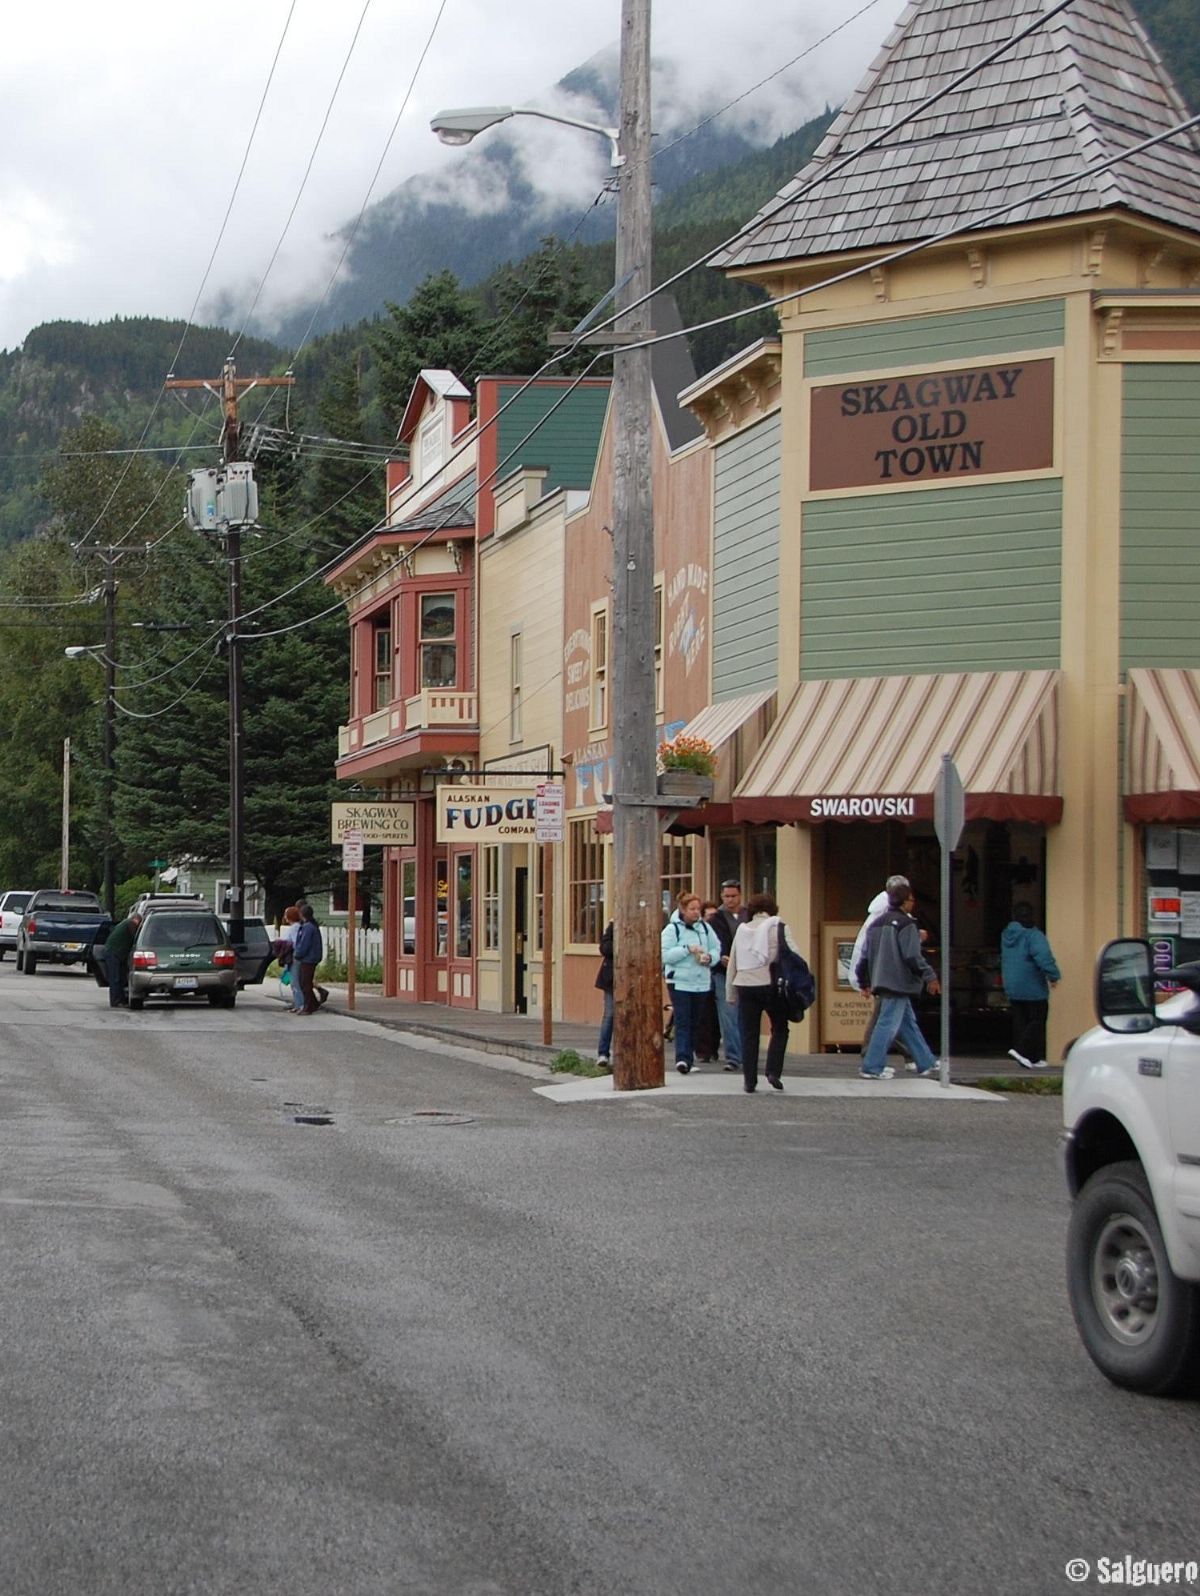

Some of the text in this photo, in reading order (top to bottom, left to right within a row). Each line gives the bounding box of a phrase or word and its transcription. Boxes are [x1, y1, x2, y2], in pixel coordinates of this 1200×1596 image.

[840, 368, 1023, 417] SKAGWAY
[891, 409, 967, 443] OLD
[874, 440, 985, 478] TOWN
[447, 794, 490, 803] ALASKAN
[345, 807, 399, 818] SKAGWAY
[810, 797, 915, 817] SWAROVSKI
[337, 819, 409, 830] BREWING CO
[498, 825, 535, 835] COMPAN
